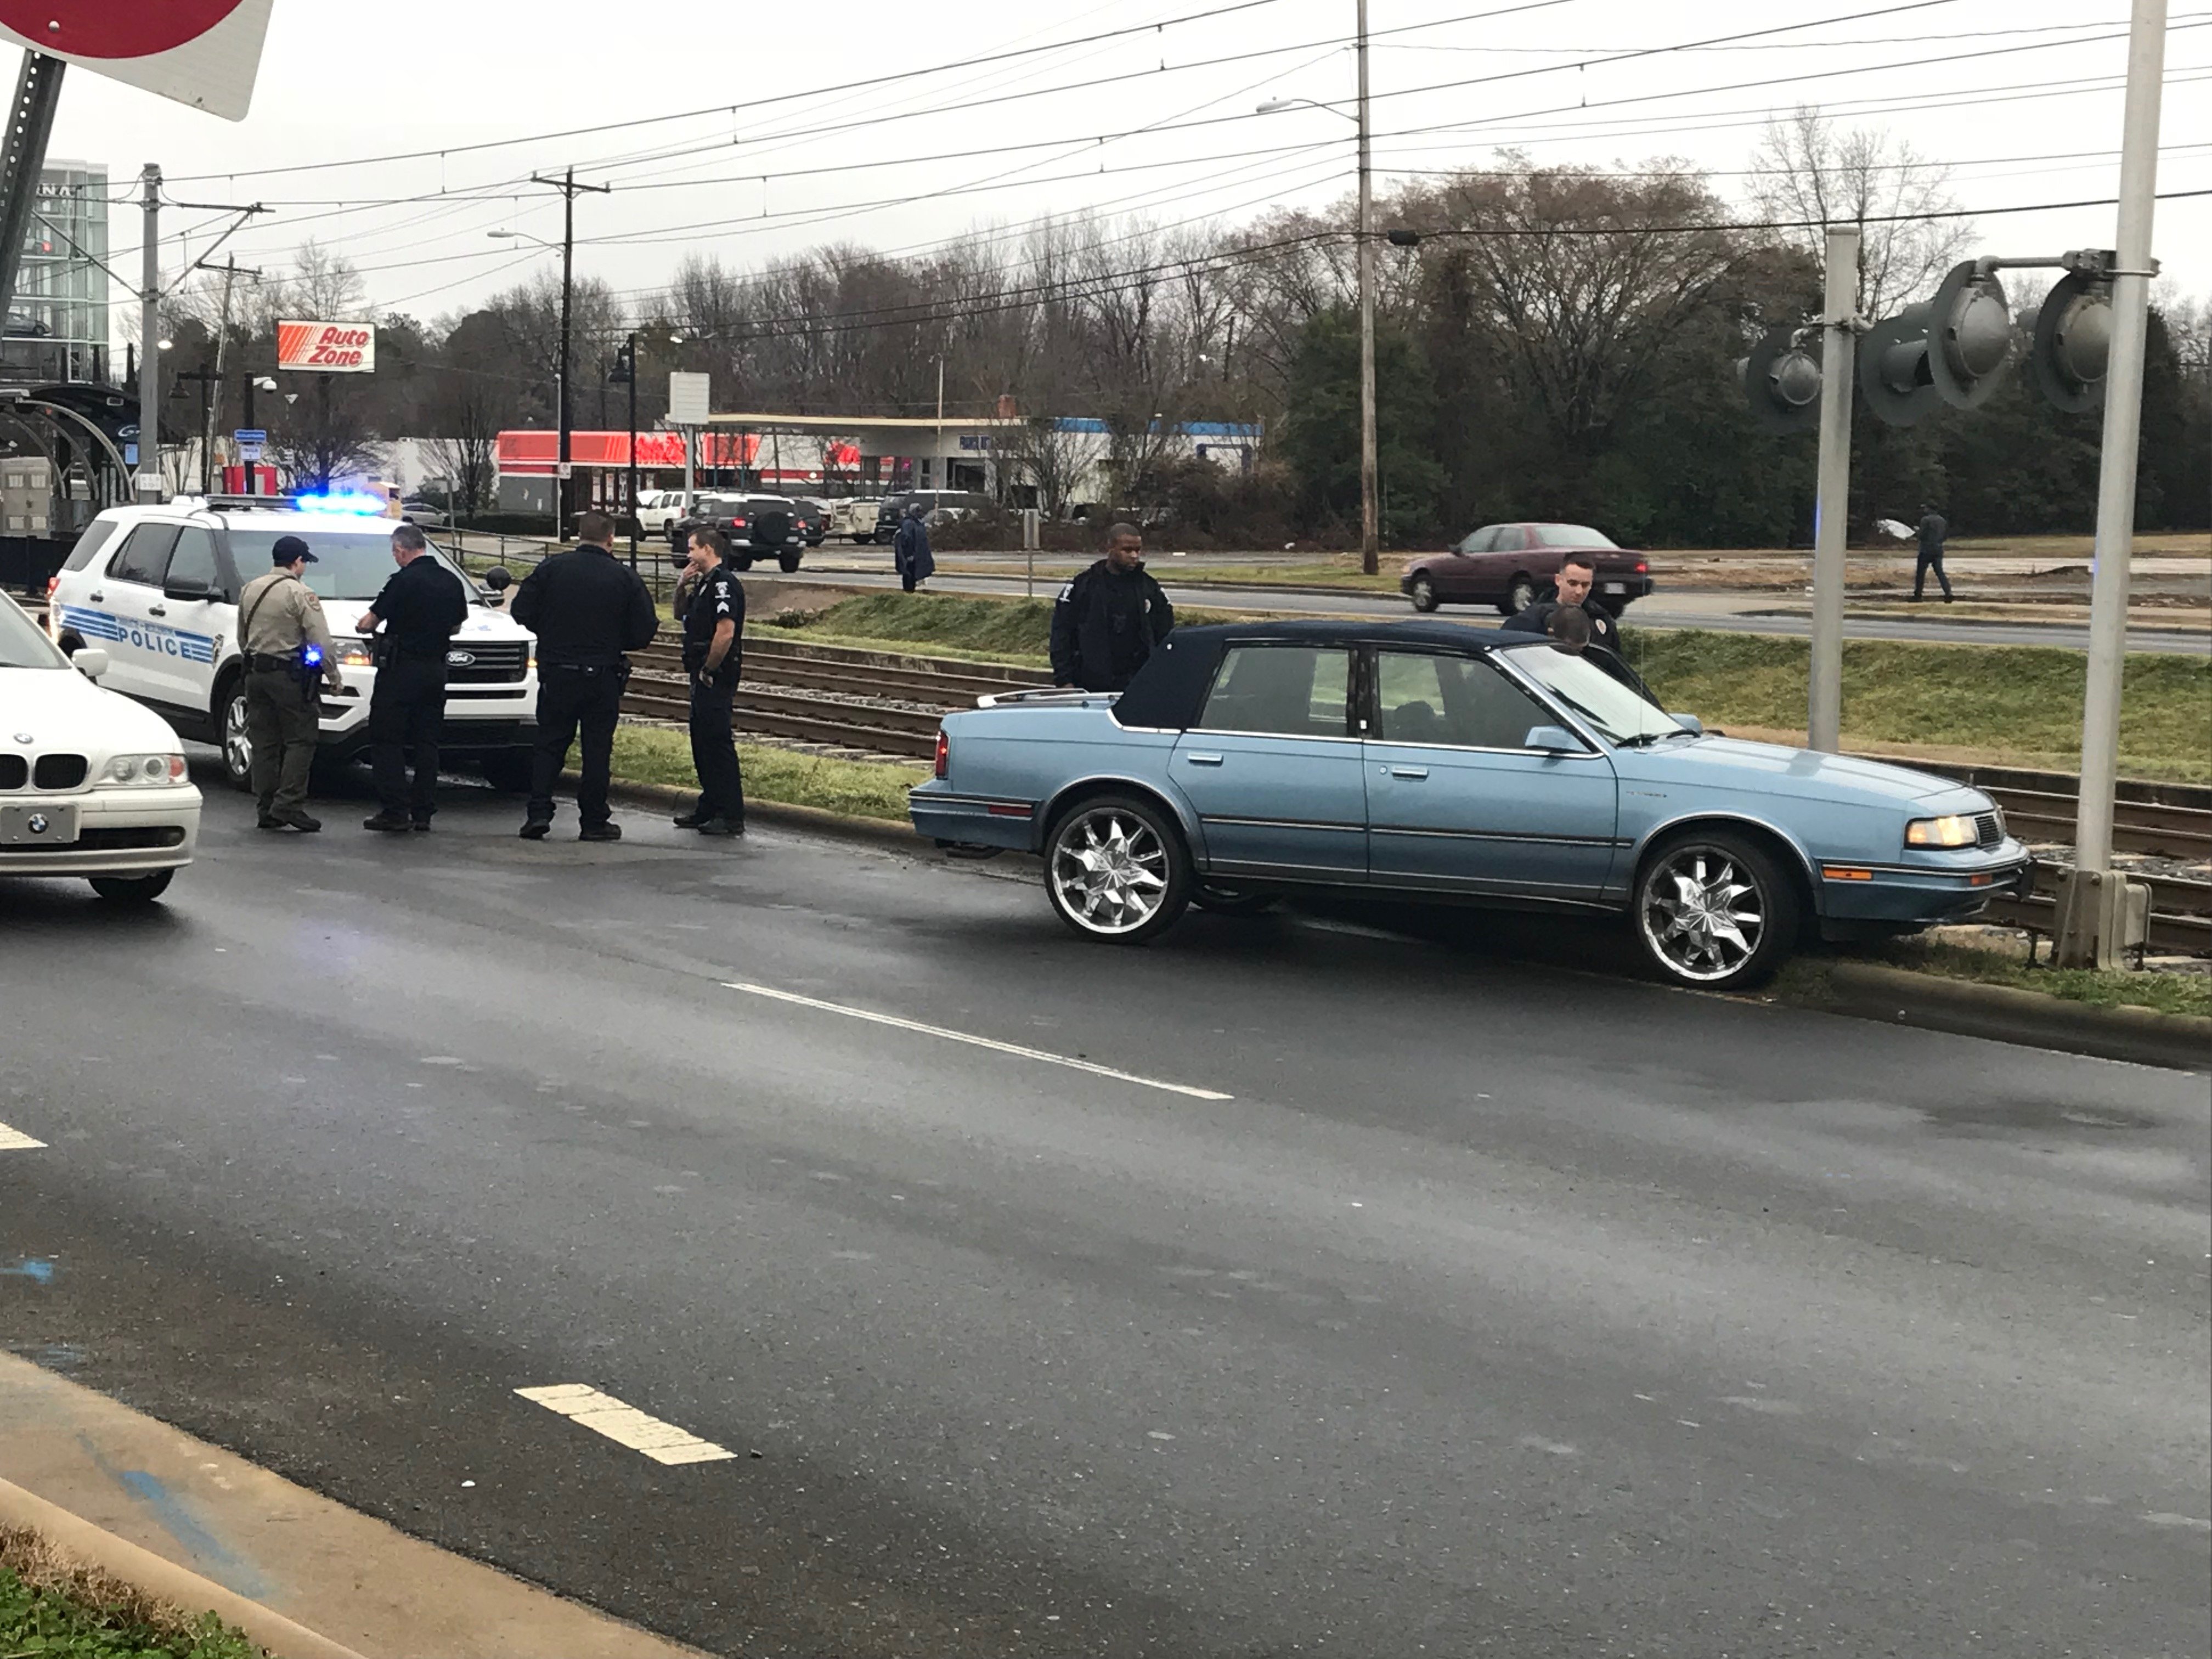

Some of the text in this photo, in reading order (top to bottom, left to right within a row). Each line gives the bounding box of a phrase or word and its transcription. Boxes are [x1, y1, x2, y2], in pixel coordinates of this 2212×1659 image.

[318, 326, 369, 346] Auto
[307, 345, 363, 365] Zone
[118, 627, 192, 659] POLICE
